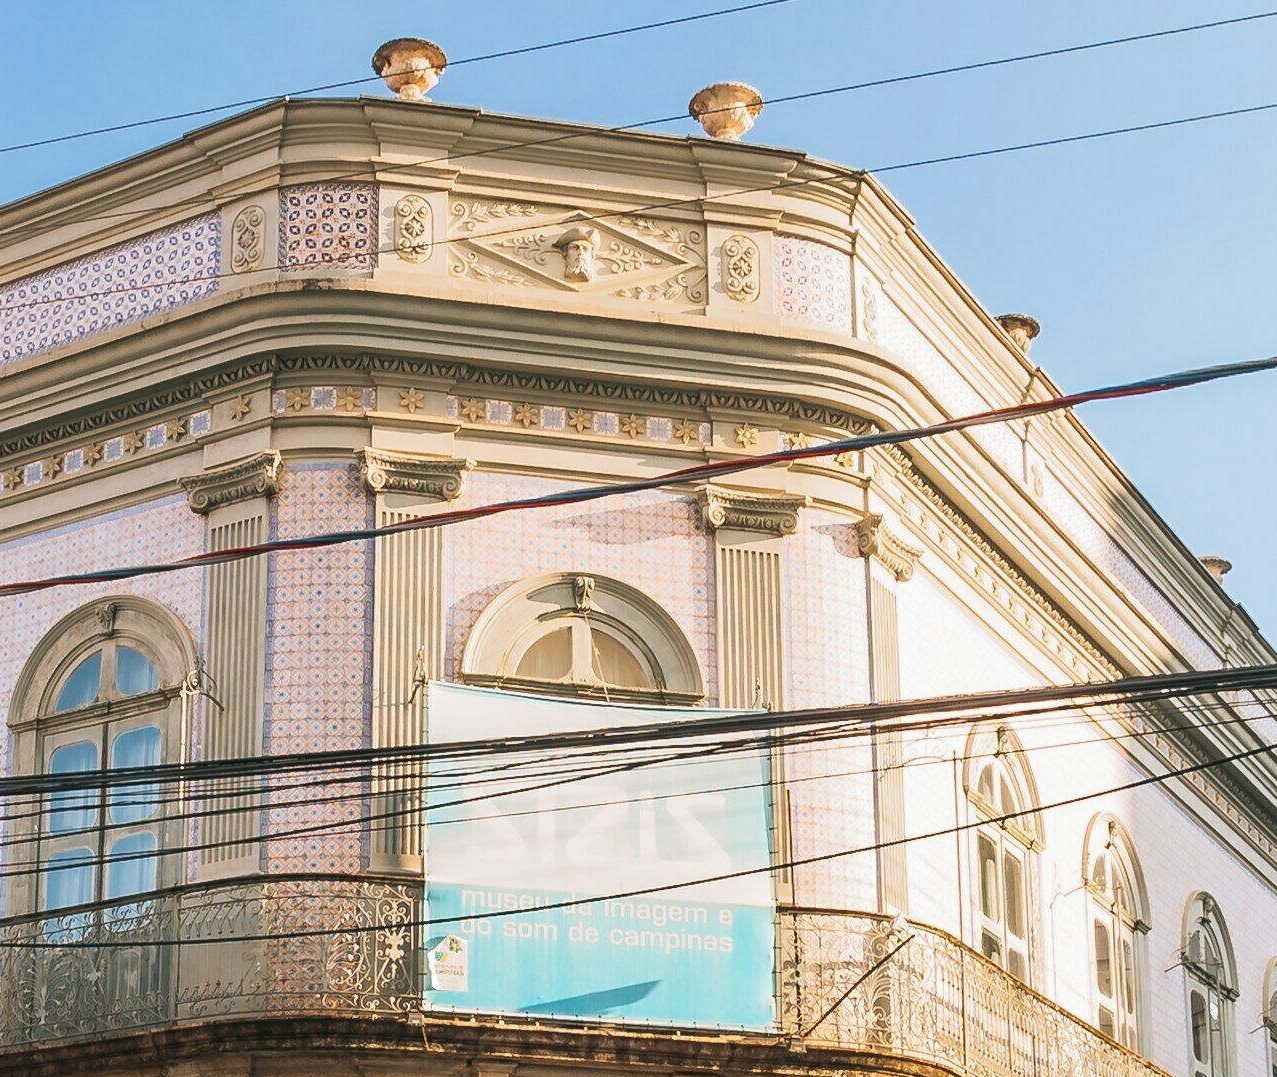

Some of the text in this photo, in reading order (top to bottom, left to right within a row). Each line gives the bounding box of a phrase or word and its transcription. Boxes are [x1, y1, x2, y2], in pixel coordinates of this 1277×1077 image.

[461, 888, 733, 926] museu da imagem e
[460, 916, 733, 953] do som de campinas
